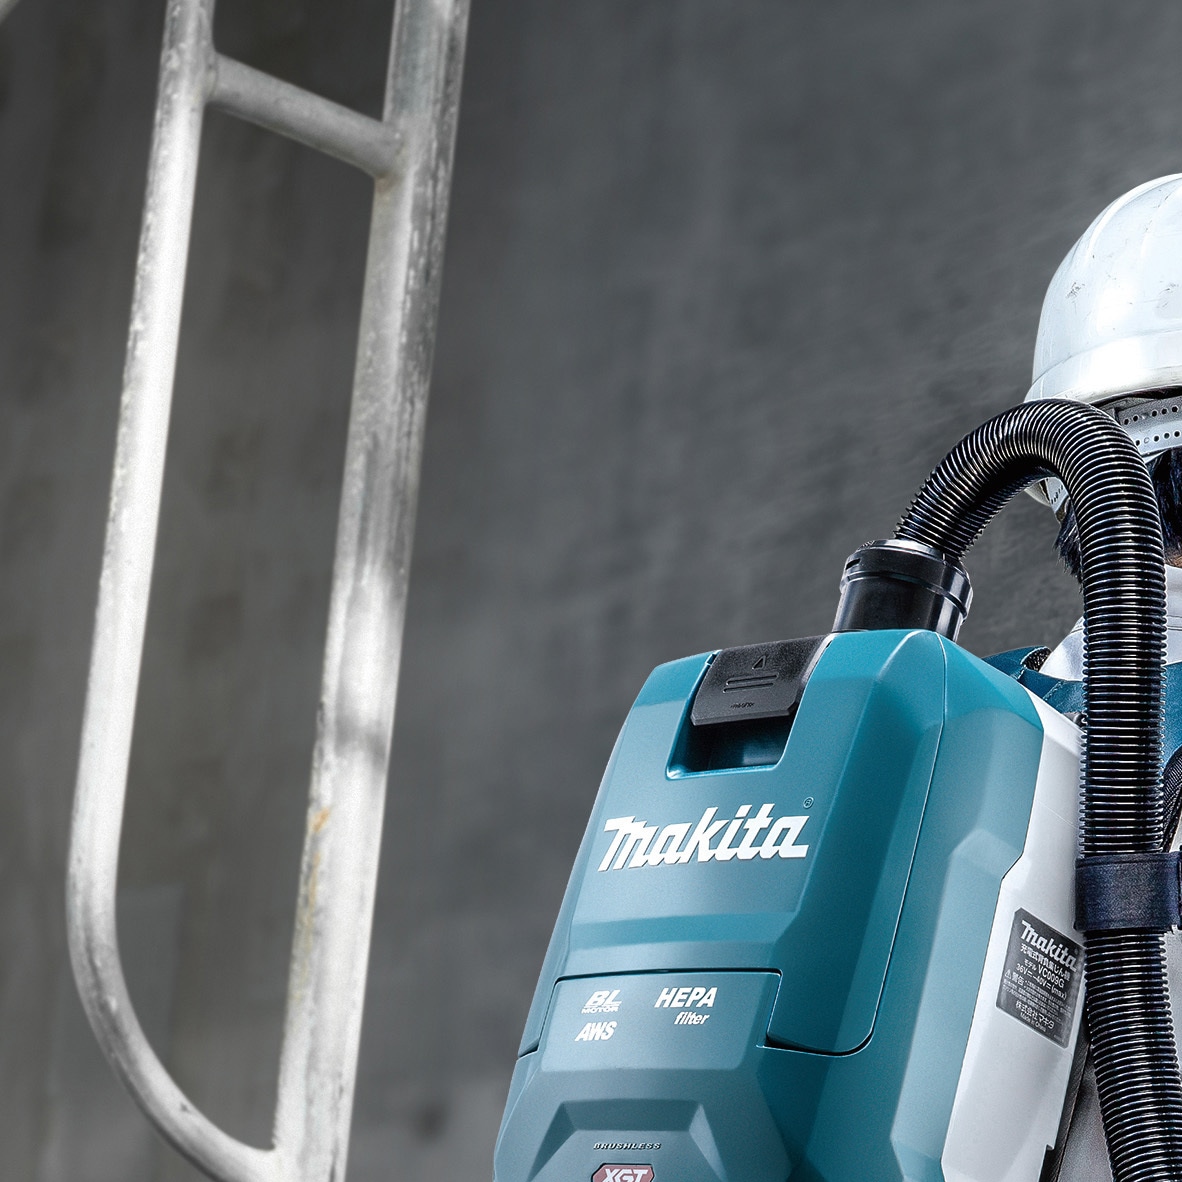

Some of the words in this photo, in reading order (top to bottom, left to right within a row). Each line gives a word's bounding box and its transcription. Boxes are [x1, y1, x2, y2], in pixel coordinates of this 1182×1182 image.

[585, 989, 622, 1006] BL
[654, 987, 717, 1009] HEPA
[581, 1006, 619, 1014] MOTOR
[674, 1011, 710, 1025] filter
[574, 1021, 617, 1042] AWS
[593, 1142, 661, 1150] BRUSHLESS
